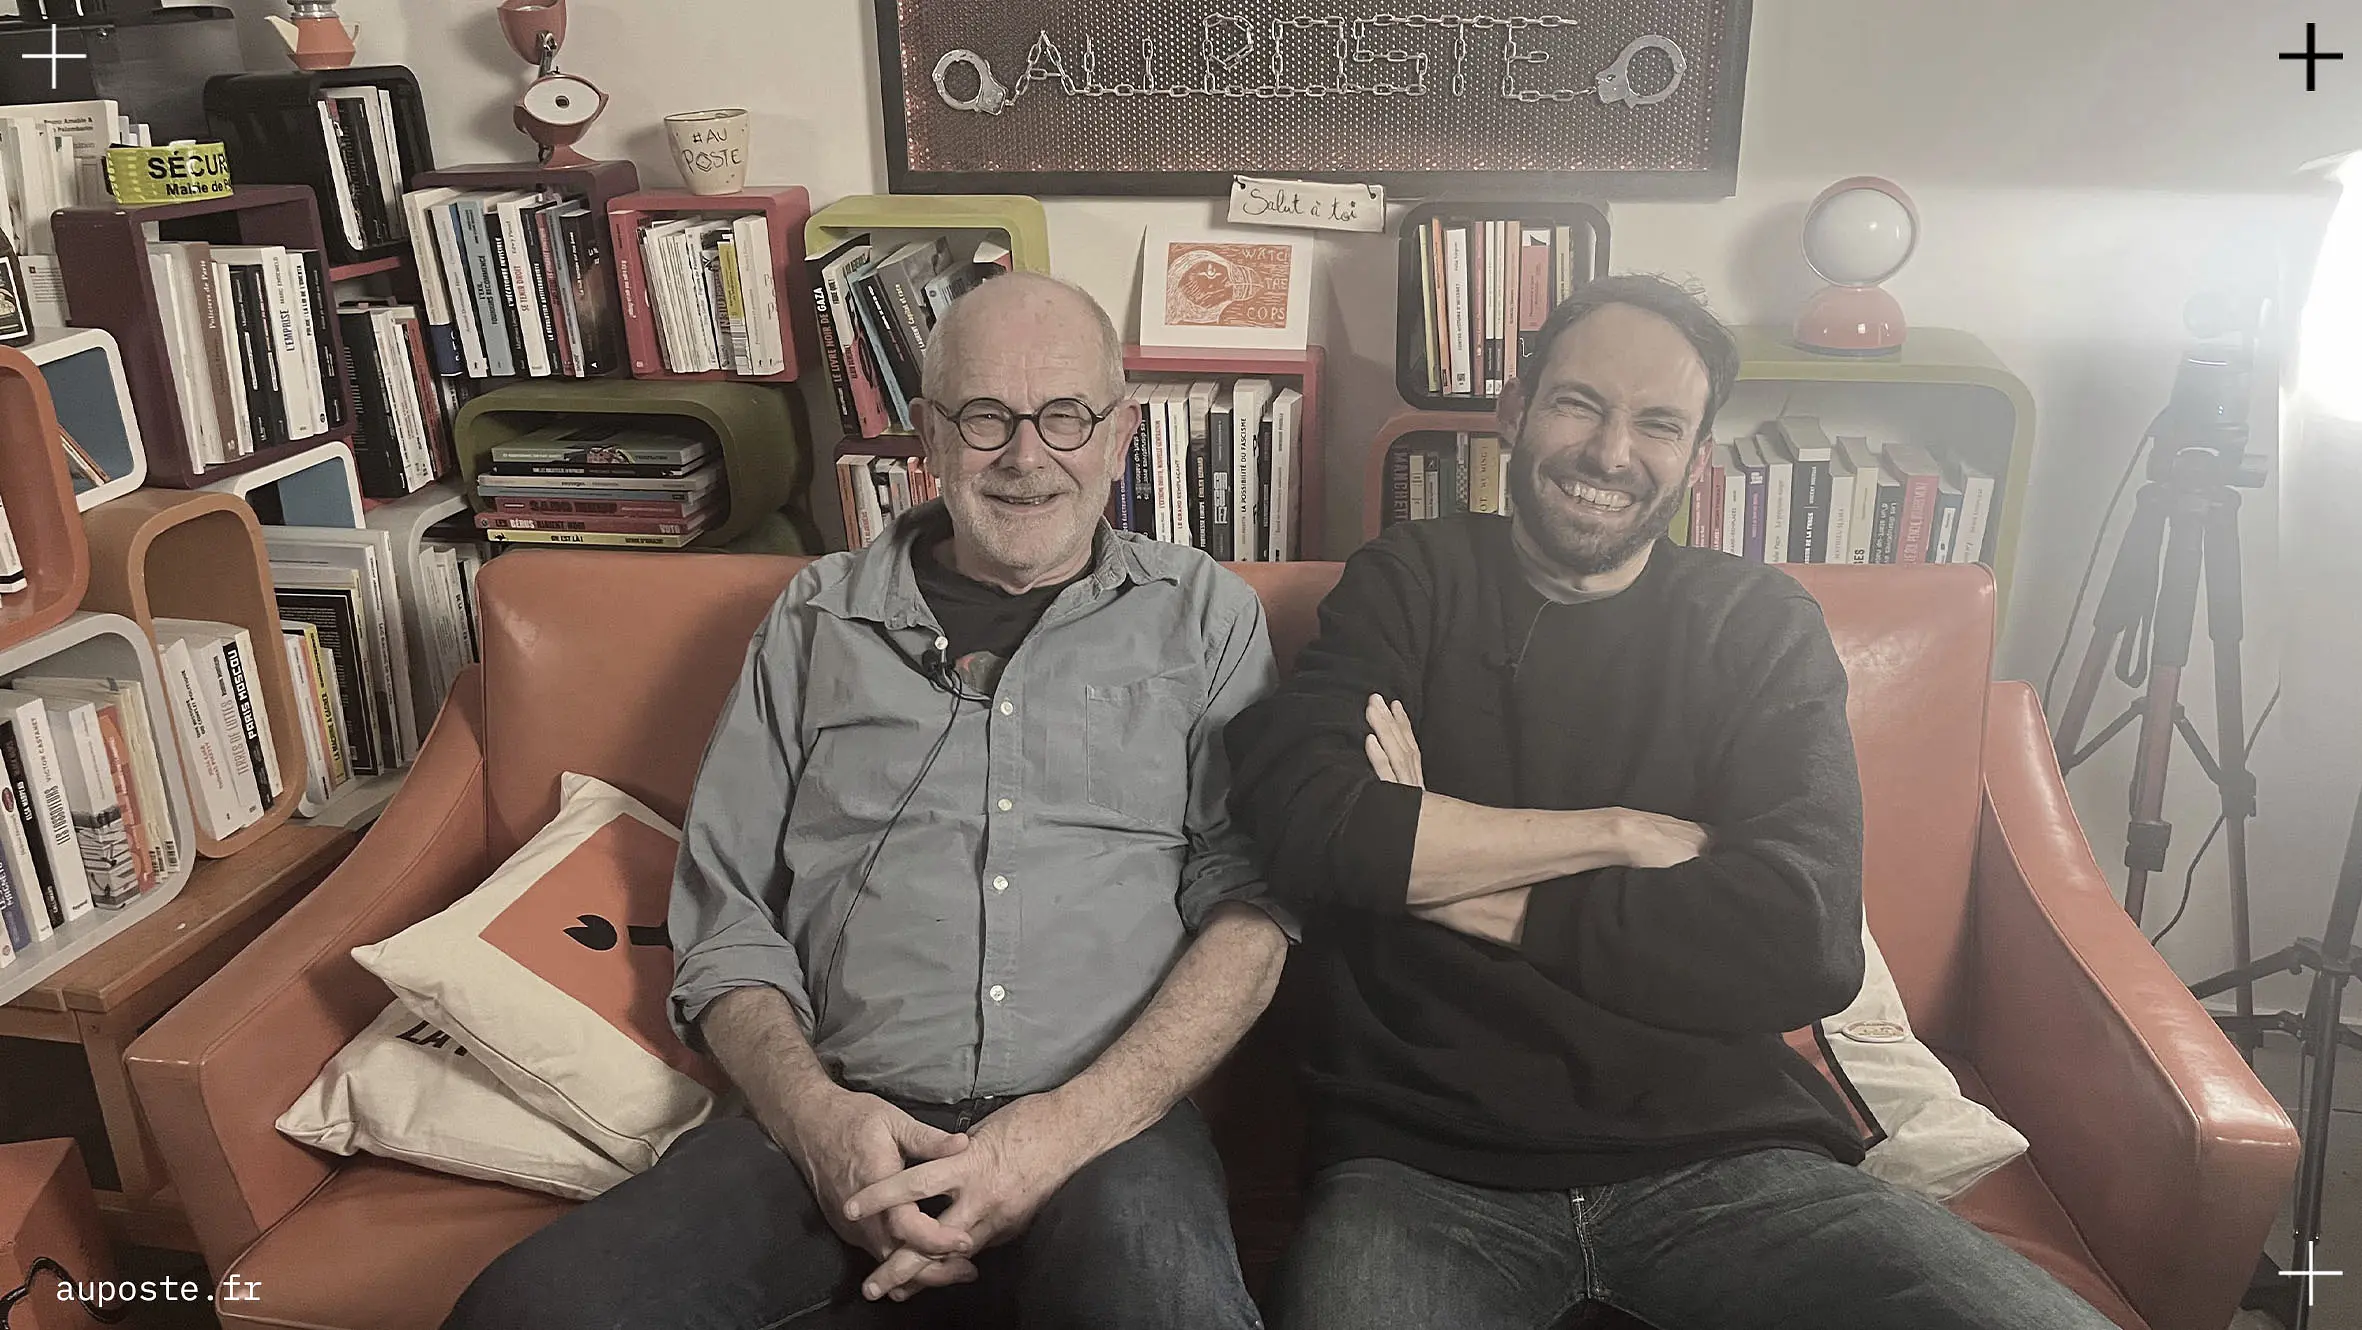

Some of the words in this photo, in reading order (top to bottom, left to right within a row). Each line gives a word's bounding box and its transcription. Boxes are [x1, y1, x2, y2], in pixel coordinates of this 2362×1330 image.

[682, 148, 743, 175] POSTE
[1242, 188, 1304, 216] Salut
[1310, 201, 1321, 217] à
[1327, 198, 1358, 222] toi
[814, 286, 827, 312] GAZA
[819, 312, 829, 324] DE
[1246, 306, 1286, 321] COPS
[278, 308, 295, 351] L'EMPRISE
[822, 326, 834, 347] NOIR
[827, 347, 840, 372] LIVRE
[833, 372, 842, 383] LE
[1240, 453, 1246, 461] DU
[1240, 503, 1246, 512] LA
[226, 649, 248, 699] MOSCOU
[218, 699, 239, 731] LUTTES
[240, 701, 258, 738] PARIS
[29, 716, 45, 753] CASTANET
[39, 753, 53, 782] VICTOR
[230, 742, 251, 775] TERRES
